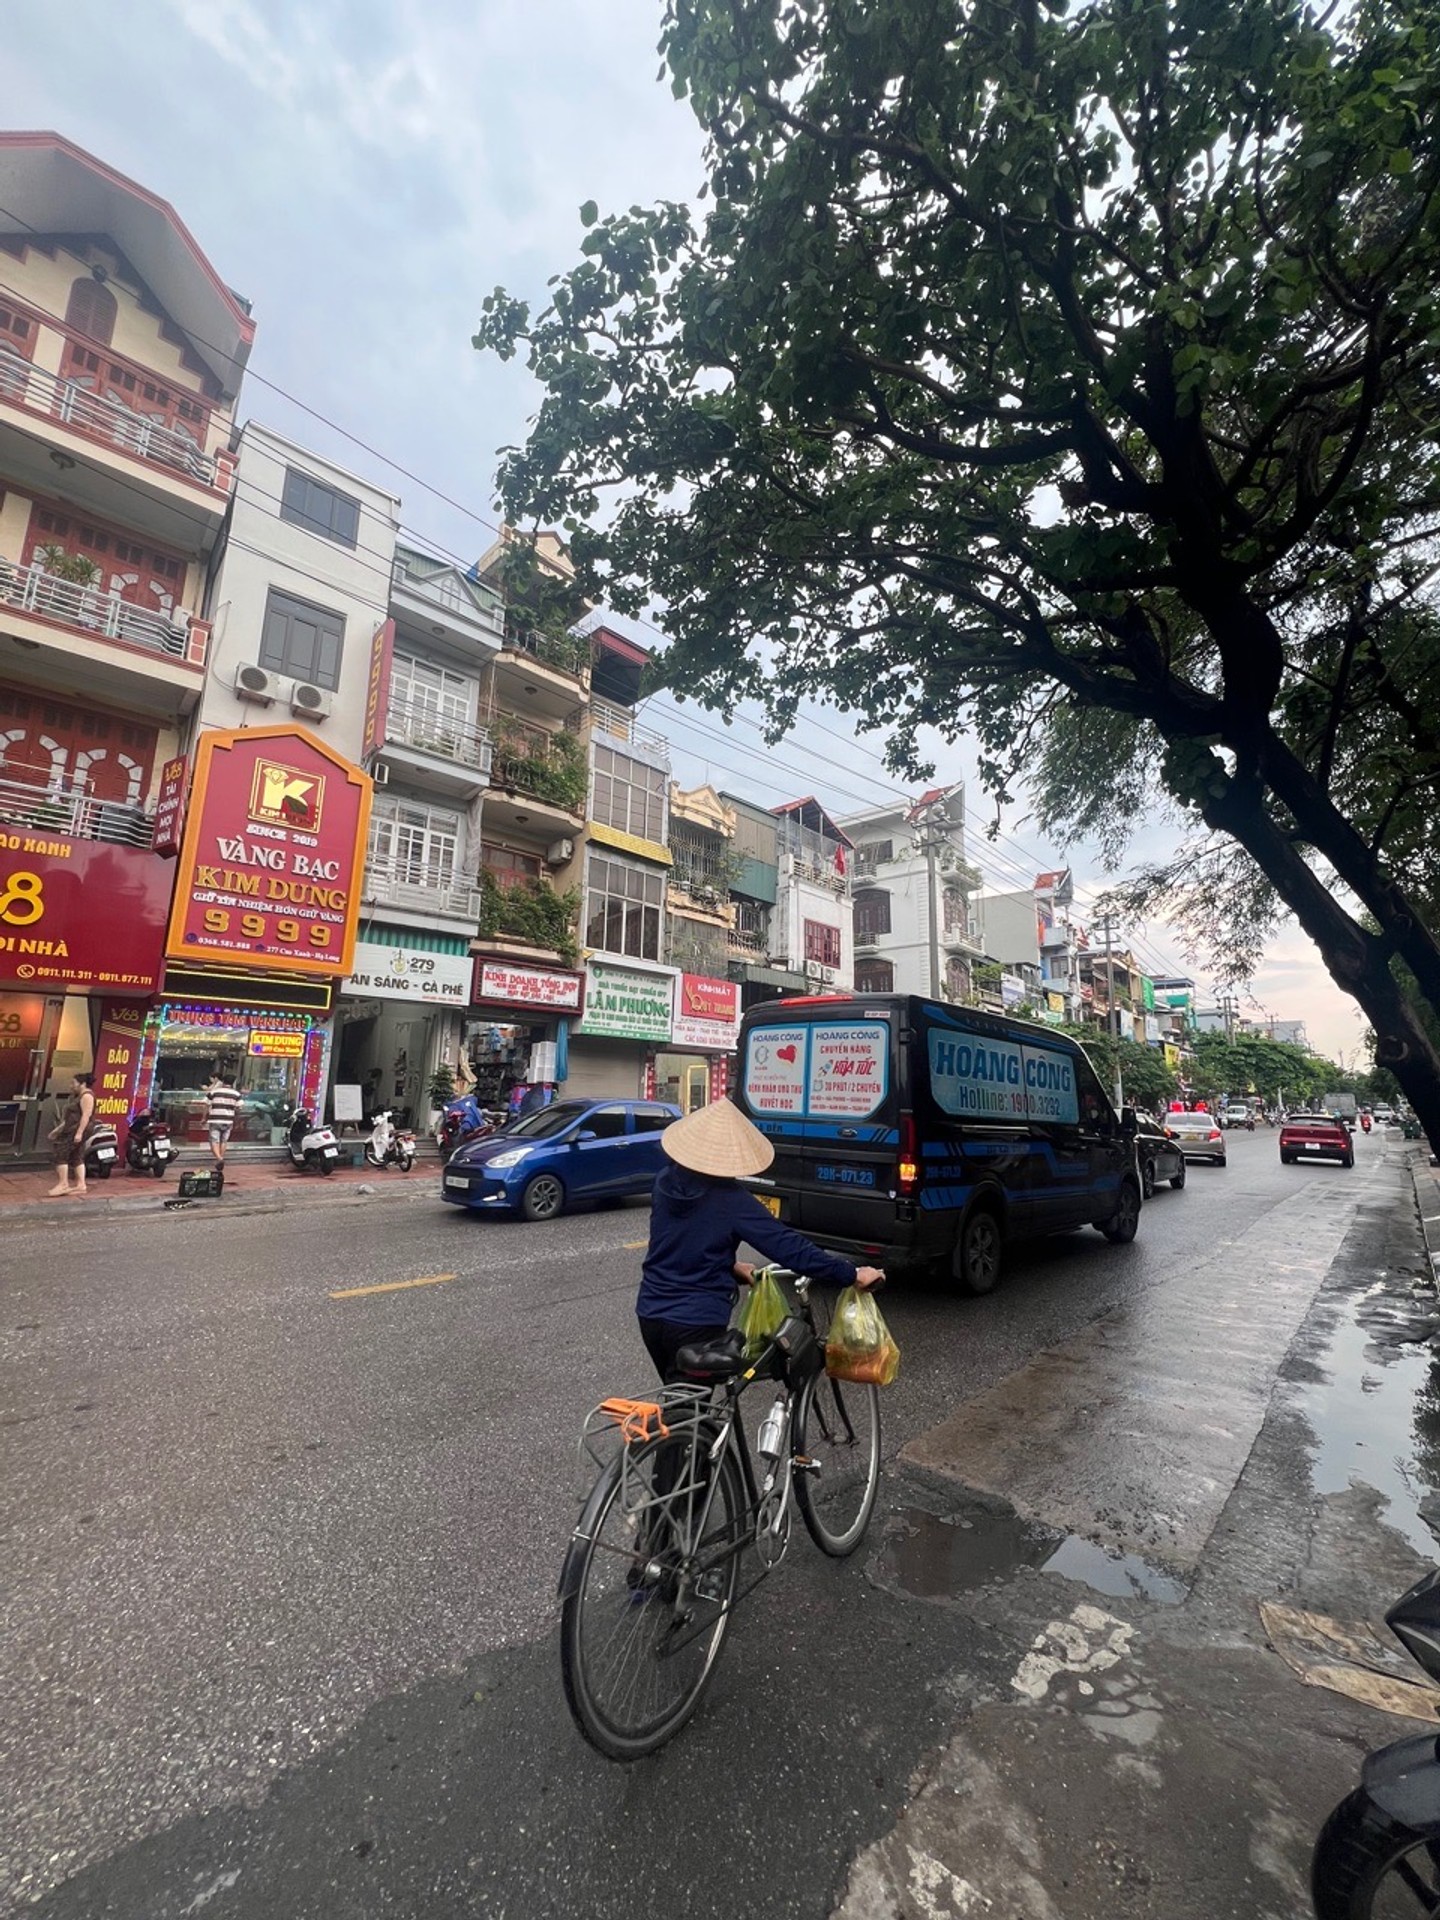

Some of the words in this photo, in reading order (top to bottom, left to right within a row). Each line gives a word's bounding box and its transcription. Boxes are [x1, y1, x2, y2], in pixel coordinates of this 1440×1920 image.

[246, 823, 287, 841] SINCE
[23, 838, 71, 858] XANH
[217, 835, 286, 870] VÀNG
[292, 853, 339, 882] BẠC
[194, 865, 262, 897] KIM
[266, 876, 347, 911] DUNG
[238, 898, 273, 913] NHIỆM
[298, 908, 319, 920] GIỮ
[319, 911, 344, 924] VÀNG
[19, 939, 68, 957] NHÀ
[410, 957, 435, 970] 279
[374, 975, 409, 990] SÁNG
[422, 980, 438, 993] CÀ
[485, 971, 507, 982] KINH
[510, 975, 538, 988] DOANH
[587, 989, 617, 1012] LÂM
[619, 996, 670, 1017] PHƯƠNG
[253, 1034, 274, 1045] KIM
[275, 1035, 302, 1047] DUNG
[107, 1044, 130, 1064] BẢO
[855, 1056, 877, 1075] TỐC
[936, 1042, 1020, 1085] HOÀNG
[1026, 1055, 1071, 1092] CÔNG
[103, 1073, 127, 1092] MẬT
[959, 1086, 1008, 1111] Hotline:
